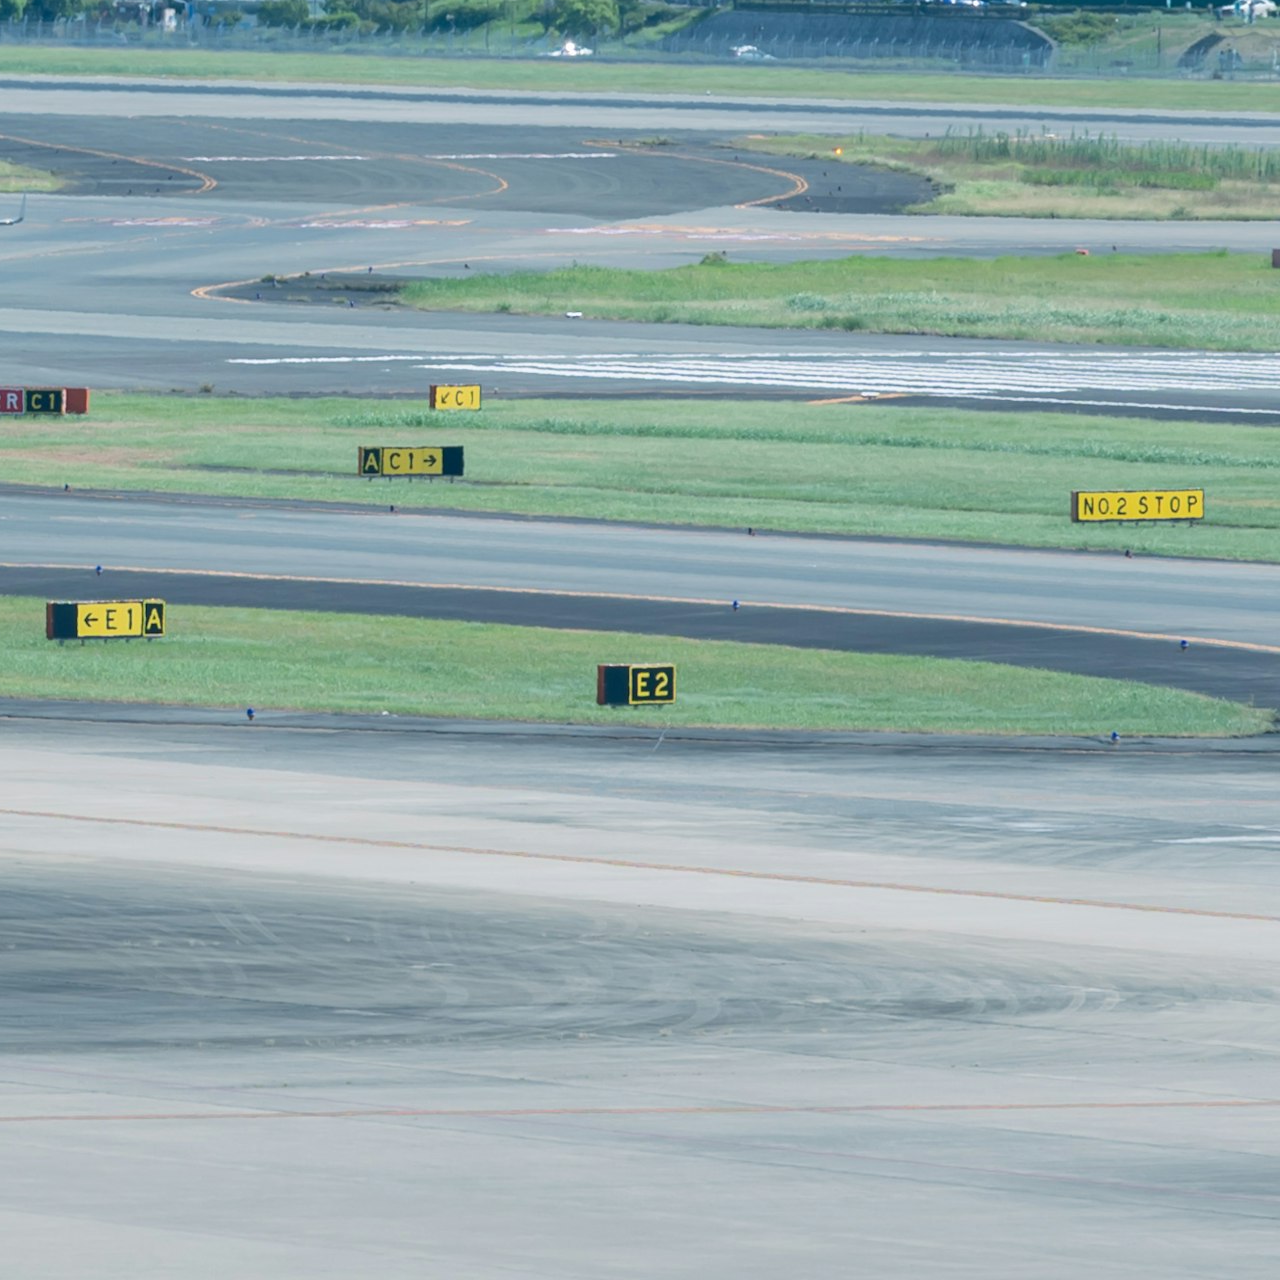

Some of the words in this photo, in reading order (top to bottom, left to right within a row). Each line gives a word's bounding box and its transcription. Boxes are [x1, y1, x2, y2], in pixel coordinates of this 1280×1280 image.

[31, 393, 56, 410] C1
[455, 390, 475, 406] C1
[364, 452, 379, 471] A
[389, 452, 415, 470] C1
[1083, 497, 1128, 516] NO.2
[1138, 495, 1198, 515] STOP
[105, 608, 134, 631] E1
[146, 608, 162, 630] A
[636, 671, 669, 698] E2
